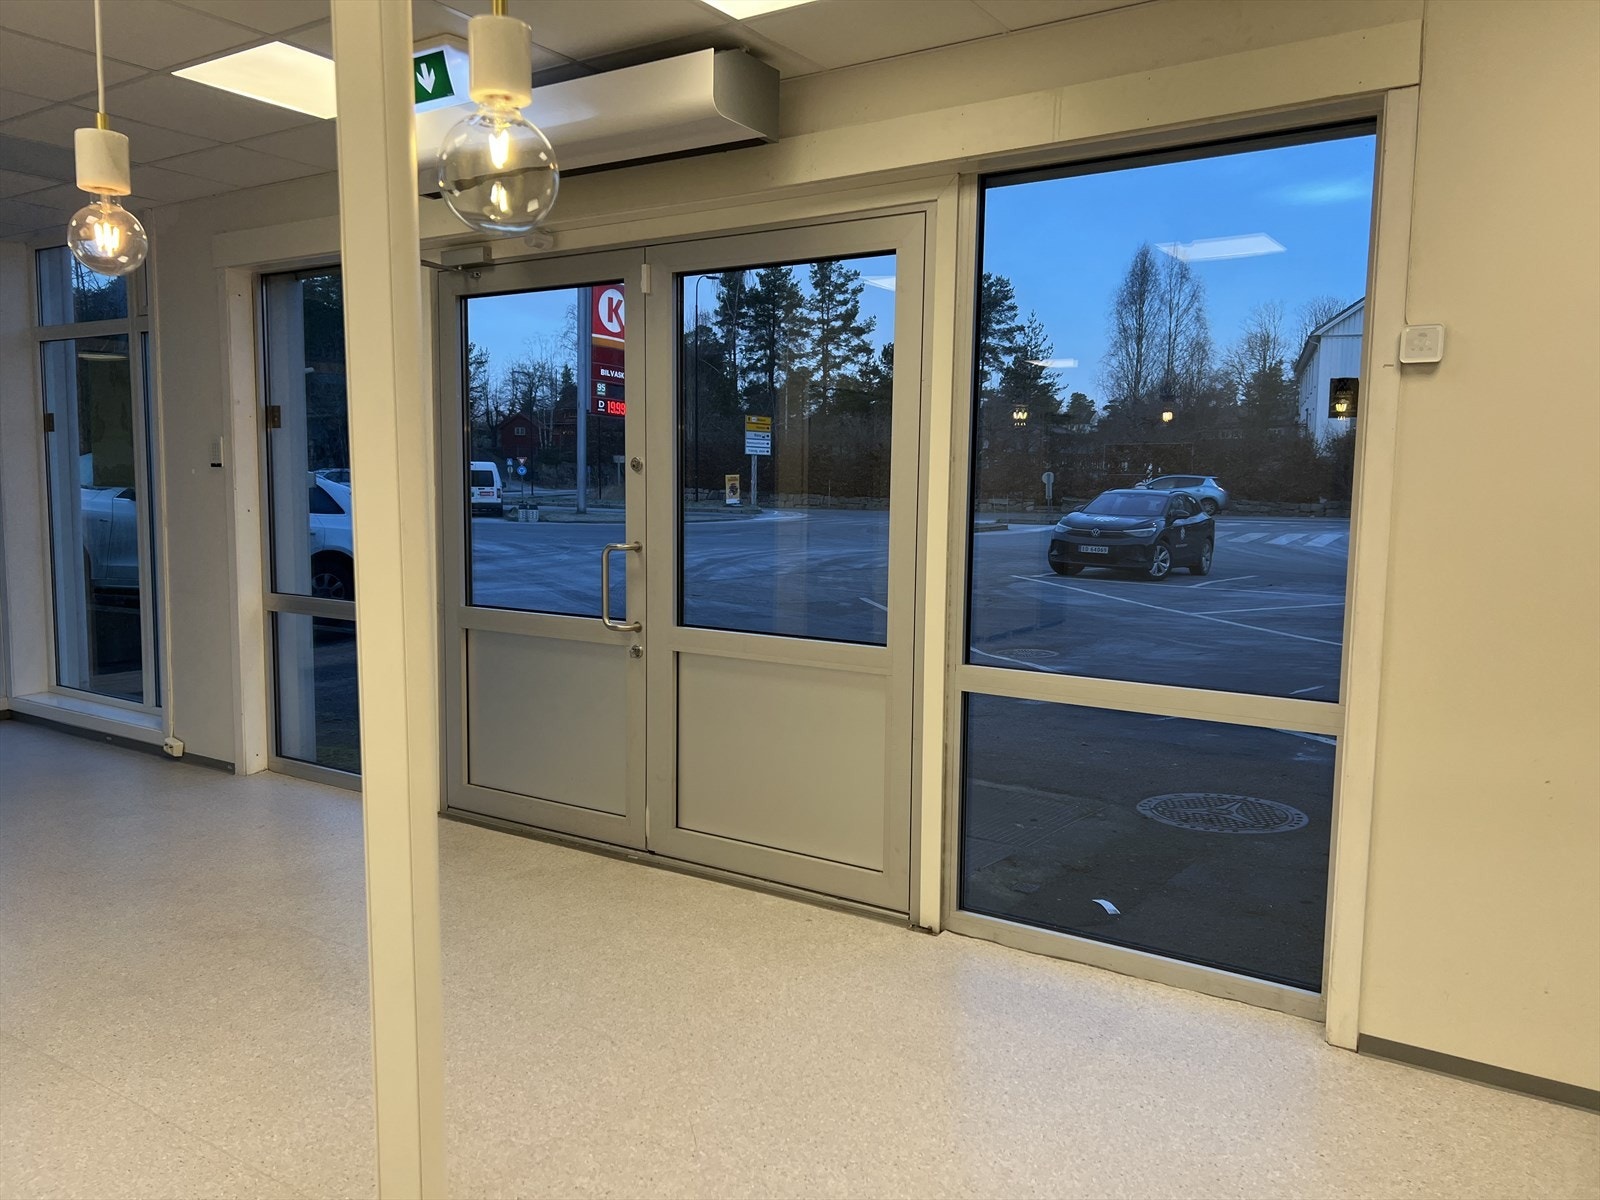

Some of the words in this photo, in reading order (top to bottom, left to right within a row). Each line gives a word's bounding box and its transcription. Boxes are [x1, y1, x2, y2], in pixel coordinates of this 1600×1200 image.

[608, 297, 624, 331] K
[600, 369, 625, 379] BILVASK
[597, 383, 606, 392] 95
[598, 400, 605, 408] D
